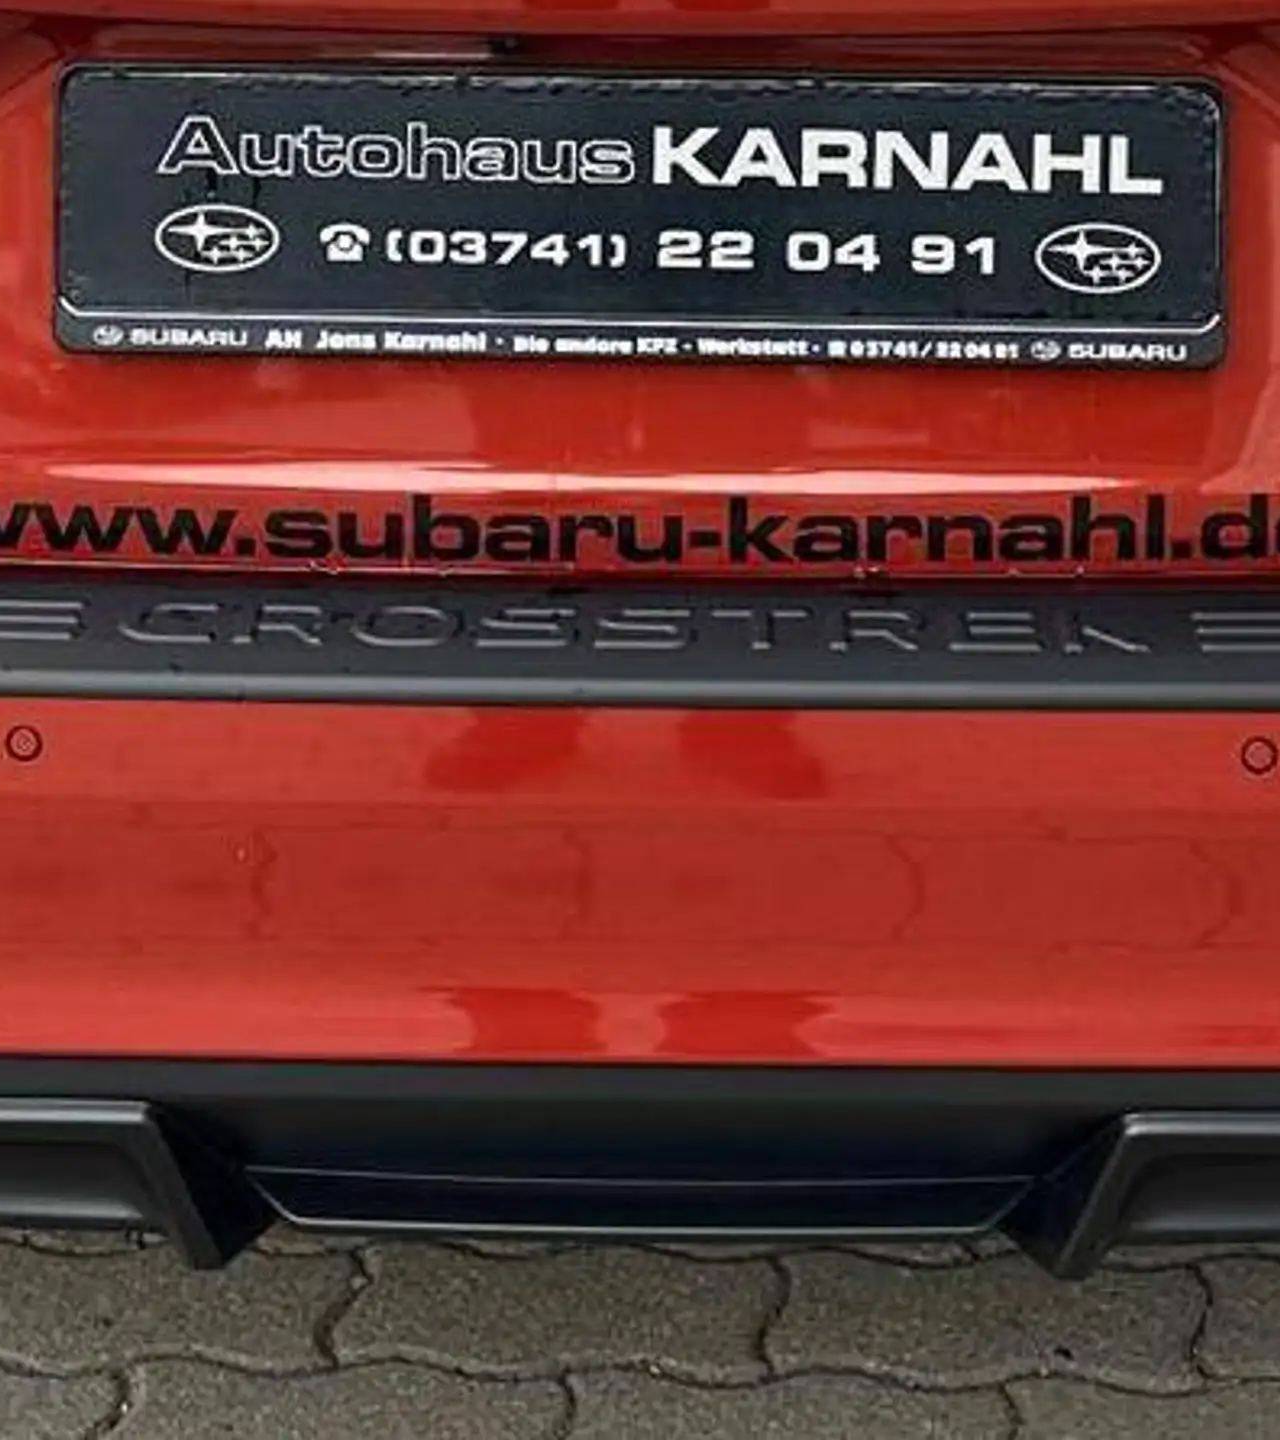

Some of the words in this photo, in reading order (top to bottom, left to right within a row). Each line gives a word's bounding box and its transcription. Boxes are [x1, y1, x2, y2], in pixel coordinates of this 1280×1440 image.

[157, 114, 636, 185] Autohaus
[652, 126, 1163, 196] KARNAHL
[386, 229, 628, 268] (03741)
[657, 230, 755, 269] 22
[785, 232, 881, 273] 04
[911, 235, 995, 275] 91
[129, 328, 247, 346] SUBARU
[384, 330, 487, 352] Karnahl
[1069, 344, 1187, 361] SUBARU
[118, 602, 1152, 654] CROSSTREK
